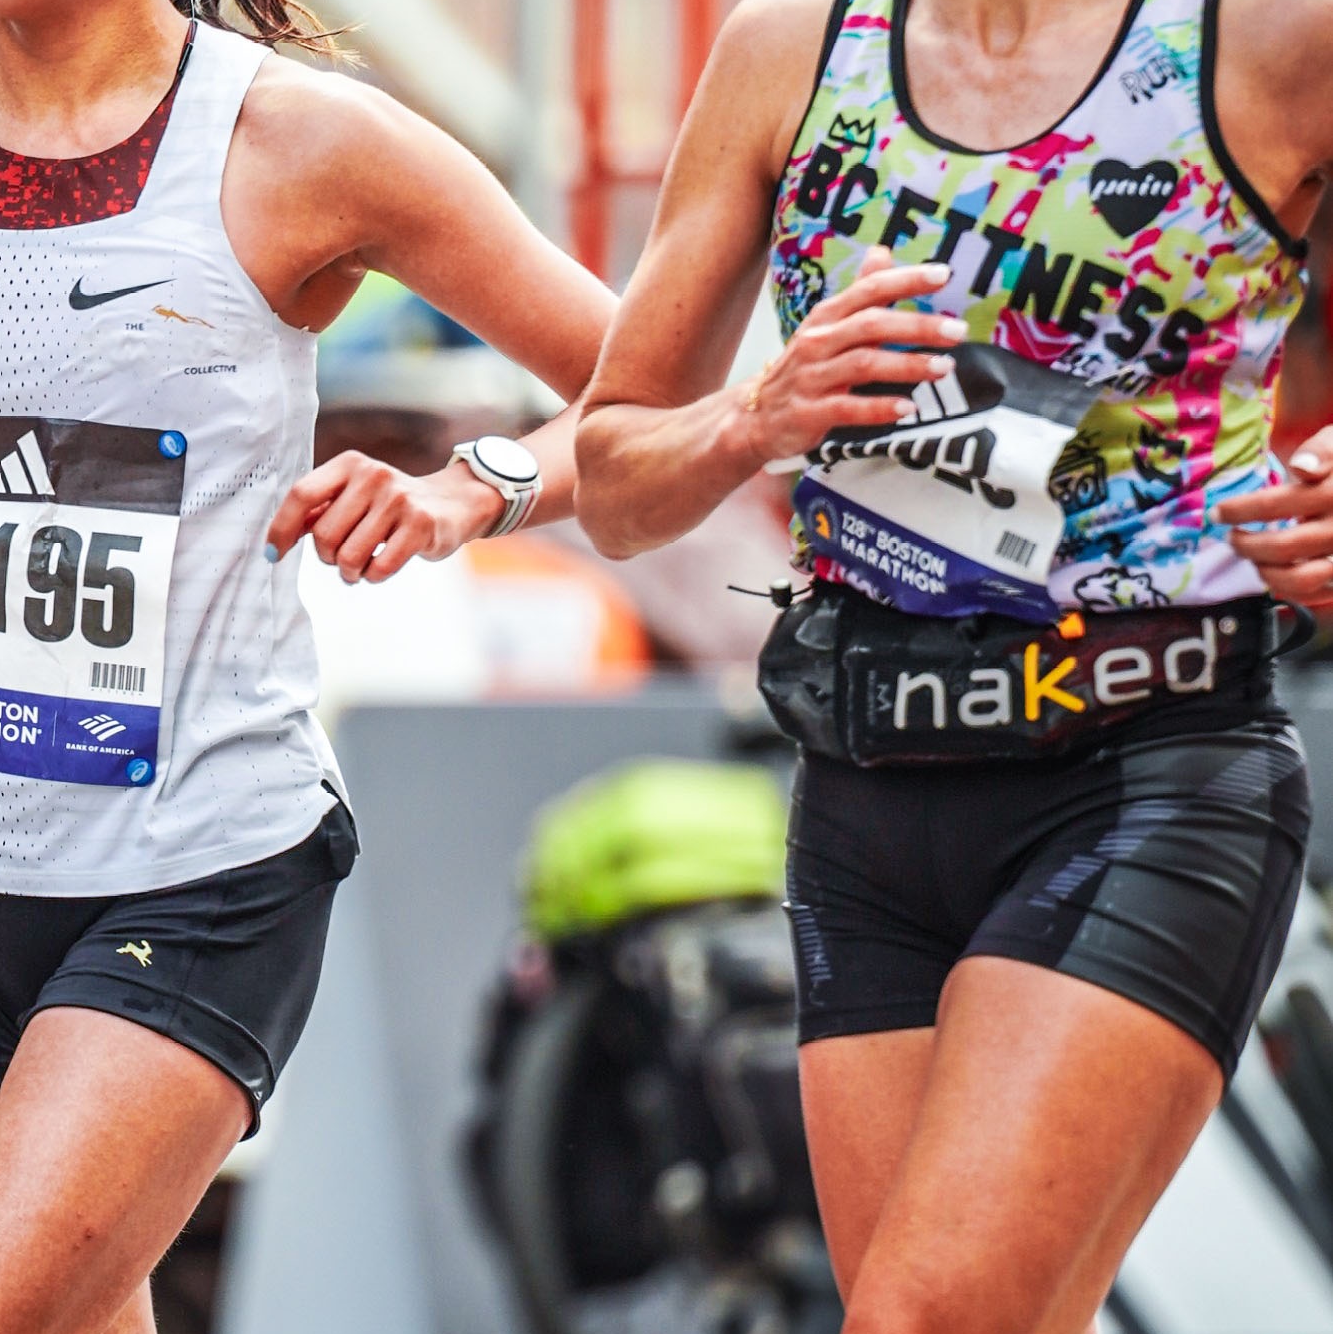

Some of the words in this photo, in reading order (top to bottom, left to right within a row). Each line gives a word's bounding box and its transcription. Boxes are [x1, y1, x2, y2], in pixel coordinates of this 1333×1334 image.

[1119, 48, 1190, 105] RUN
[795, 142, 879, 237] BC
[878, 185, 1208, 376] FITNESS
[124, 322, 145, 332] THE
[183, 364, 238, 376] COLLECTIVE
[876, 529, 948, 579] BOSTON
[65, 742, 88, 752] BANK
[87, 745, 99, 753] OF
[99, 746, 135, 756] AMERICA
